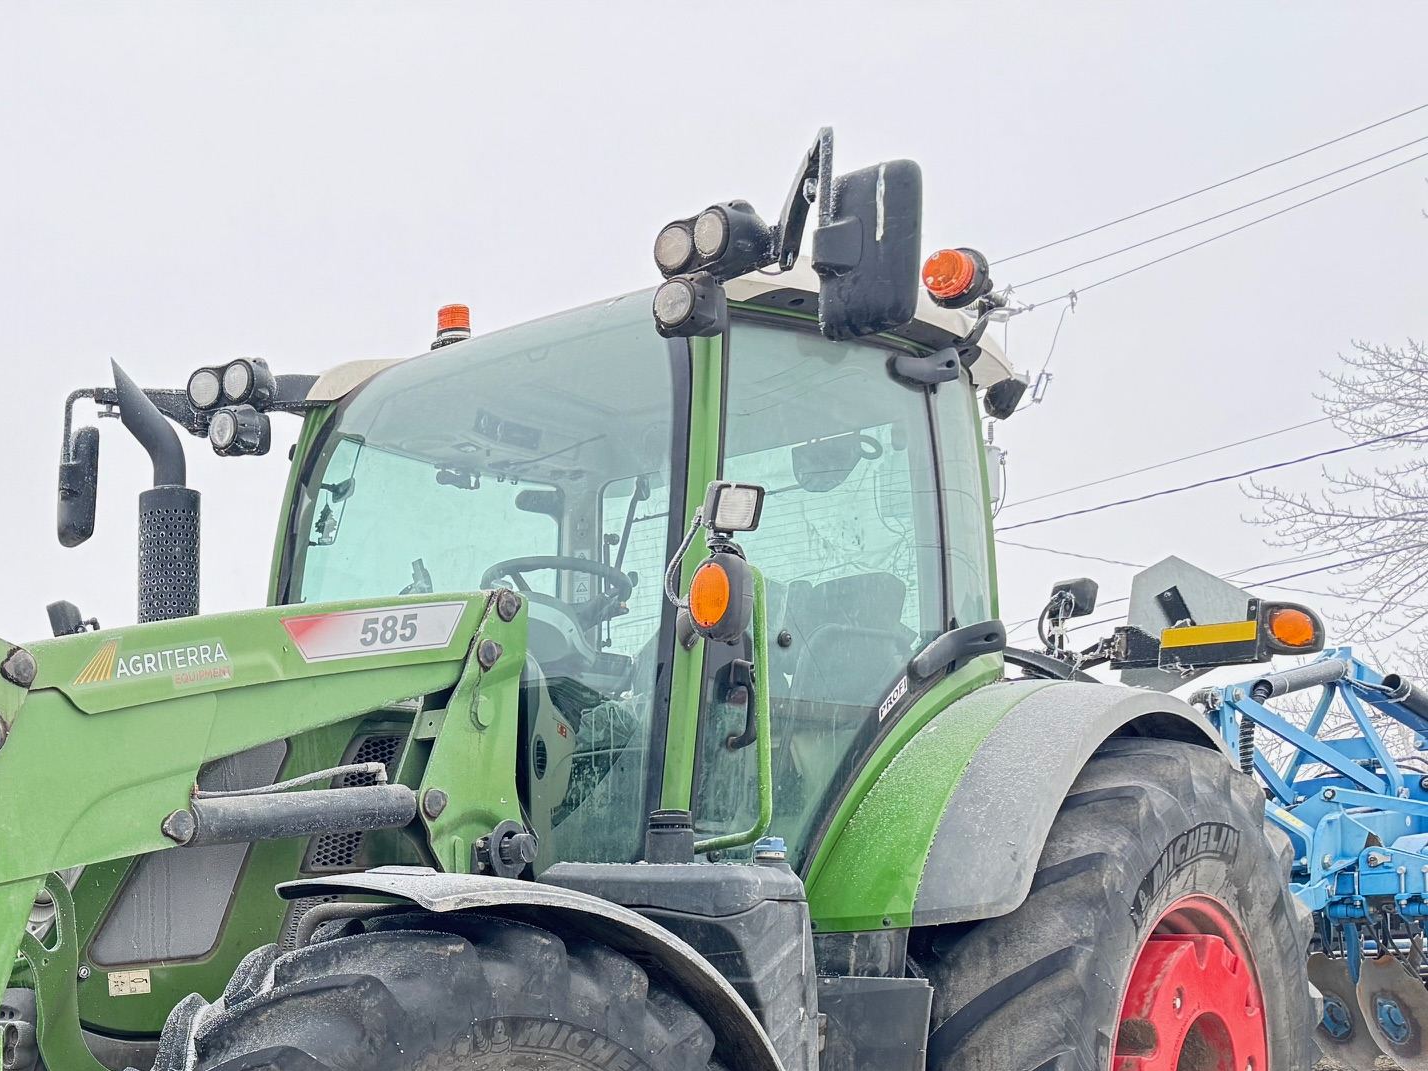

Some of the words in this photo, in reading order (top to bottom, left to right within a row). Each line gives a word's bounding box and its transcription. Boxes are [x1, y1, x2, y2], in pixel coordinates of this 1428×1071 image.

[360, 613, 418, 647] 585
[116, 643, 228, 679] AGRITERRA
[880, 678, 908, 718] PROFI
[1150, 824, 1240, 898] MICHELIN
